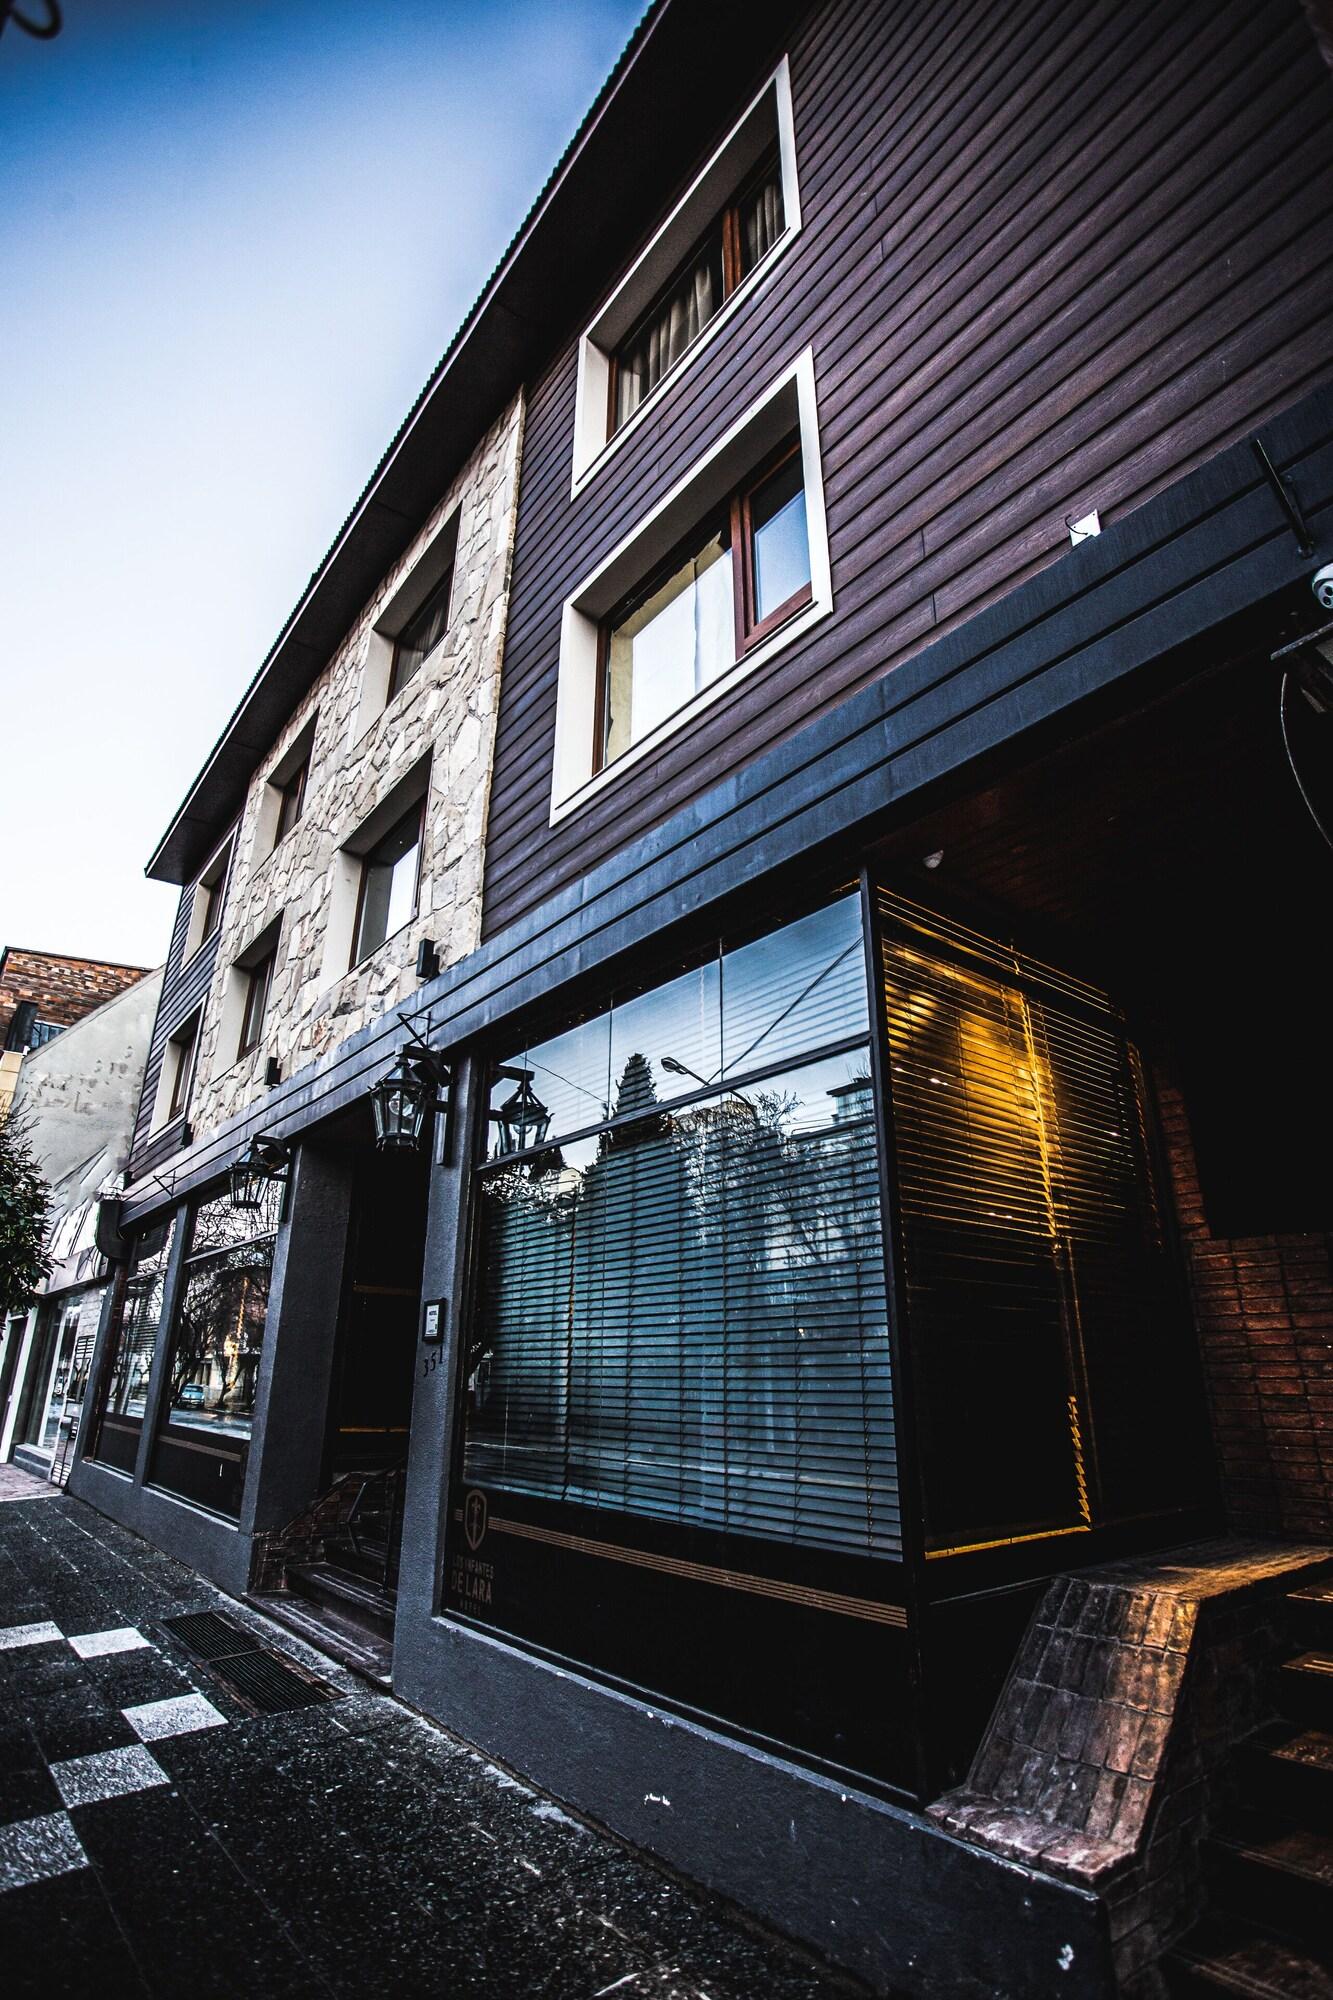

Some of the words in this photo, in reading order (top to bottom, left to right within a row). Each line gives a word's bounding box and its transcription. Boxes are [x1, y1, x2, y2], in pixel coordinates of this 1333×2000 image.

[452, 1554, 464, 1570] LOS
[465, 1559, 495, 1579] INFANTES
[450, 1570, 464, 1593] DE
[465, 1574, 493, 1605] LARA
